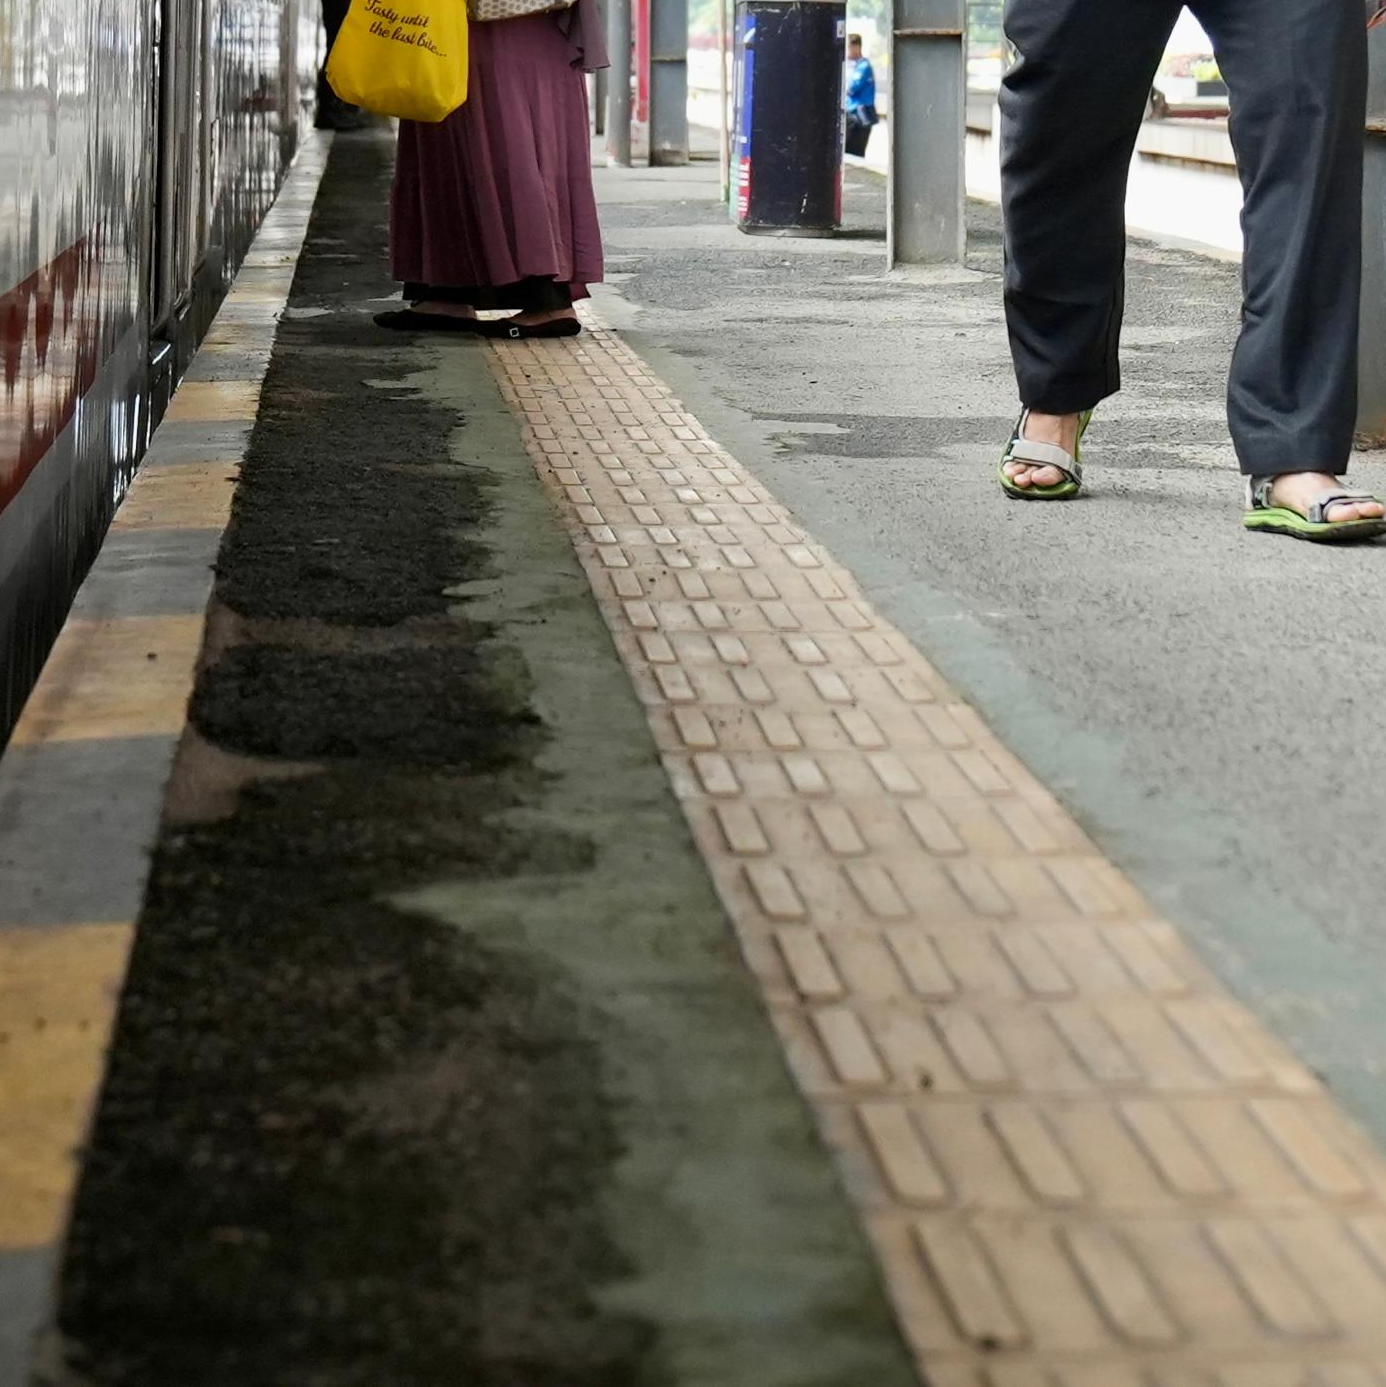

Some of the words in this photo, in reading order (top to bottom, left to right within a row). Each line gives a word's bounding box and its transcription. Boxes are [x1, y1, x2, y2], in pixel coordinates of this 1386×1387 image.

[400, 14, 430, 28] until
[369, 21, 390, 38] the
[391, 26, 416, 45] last
